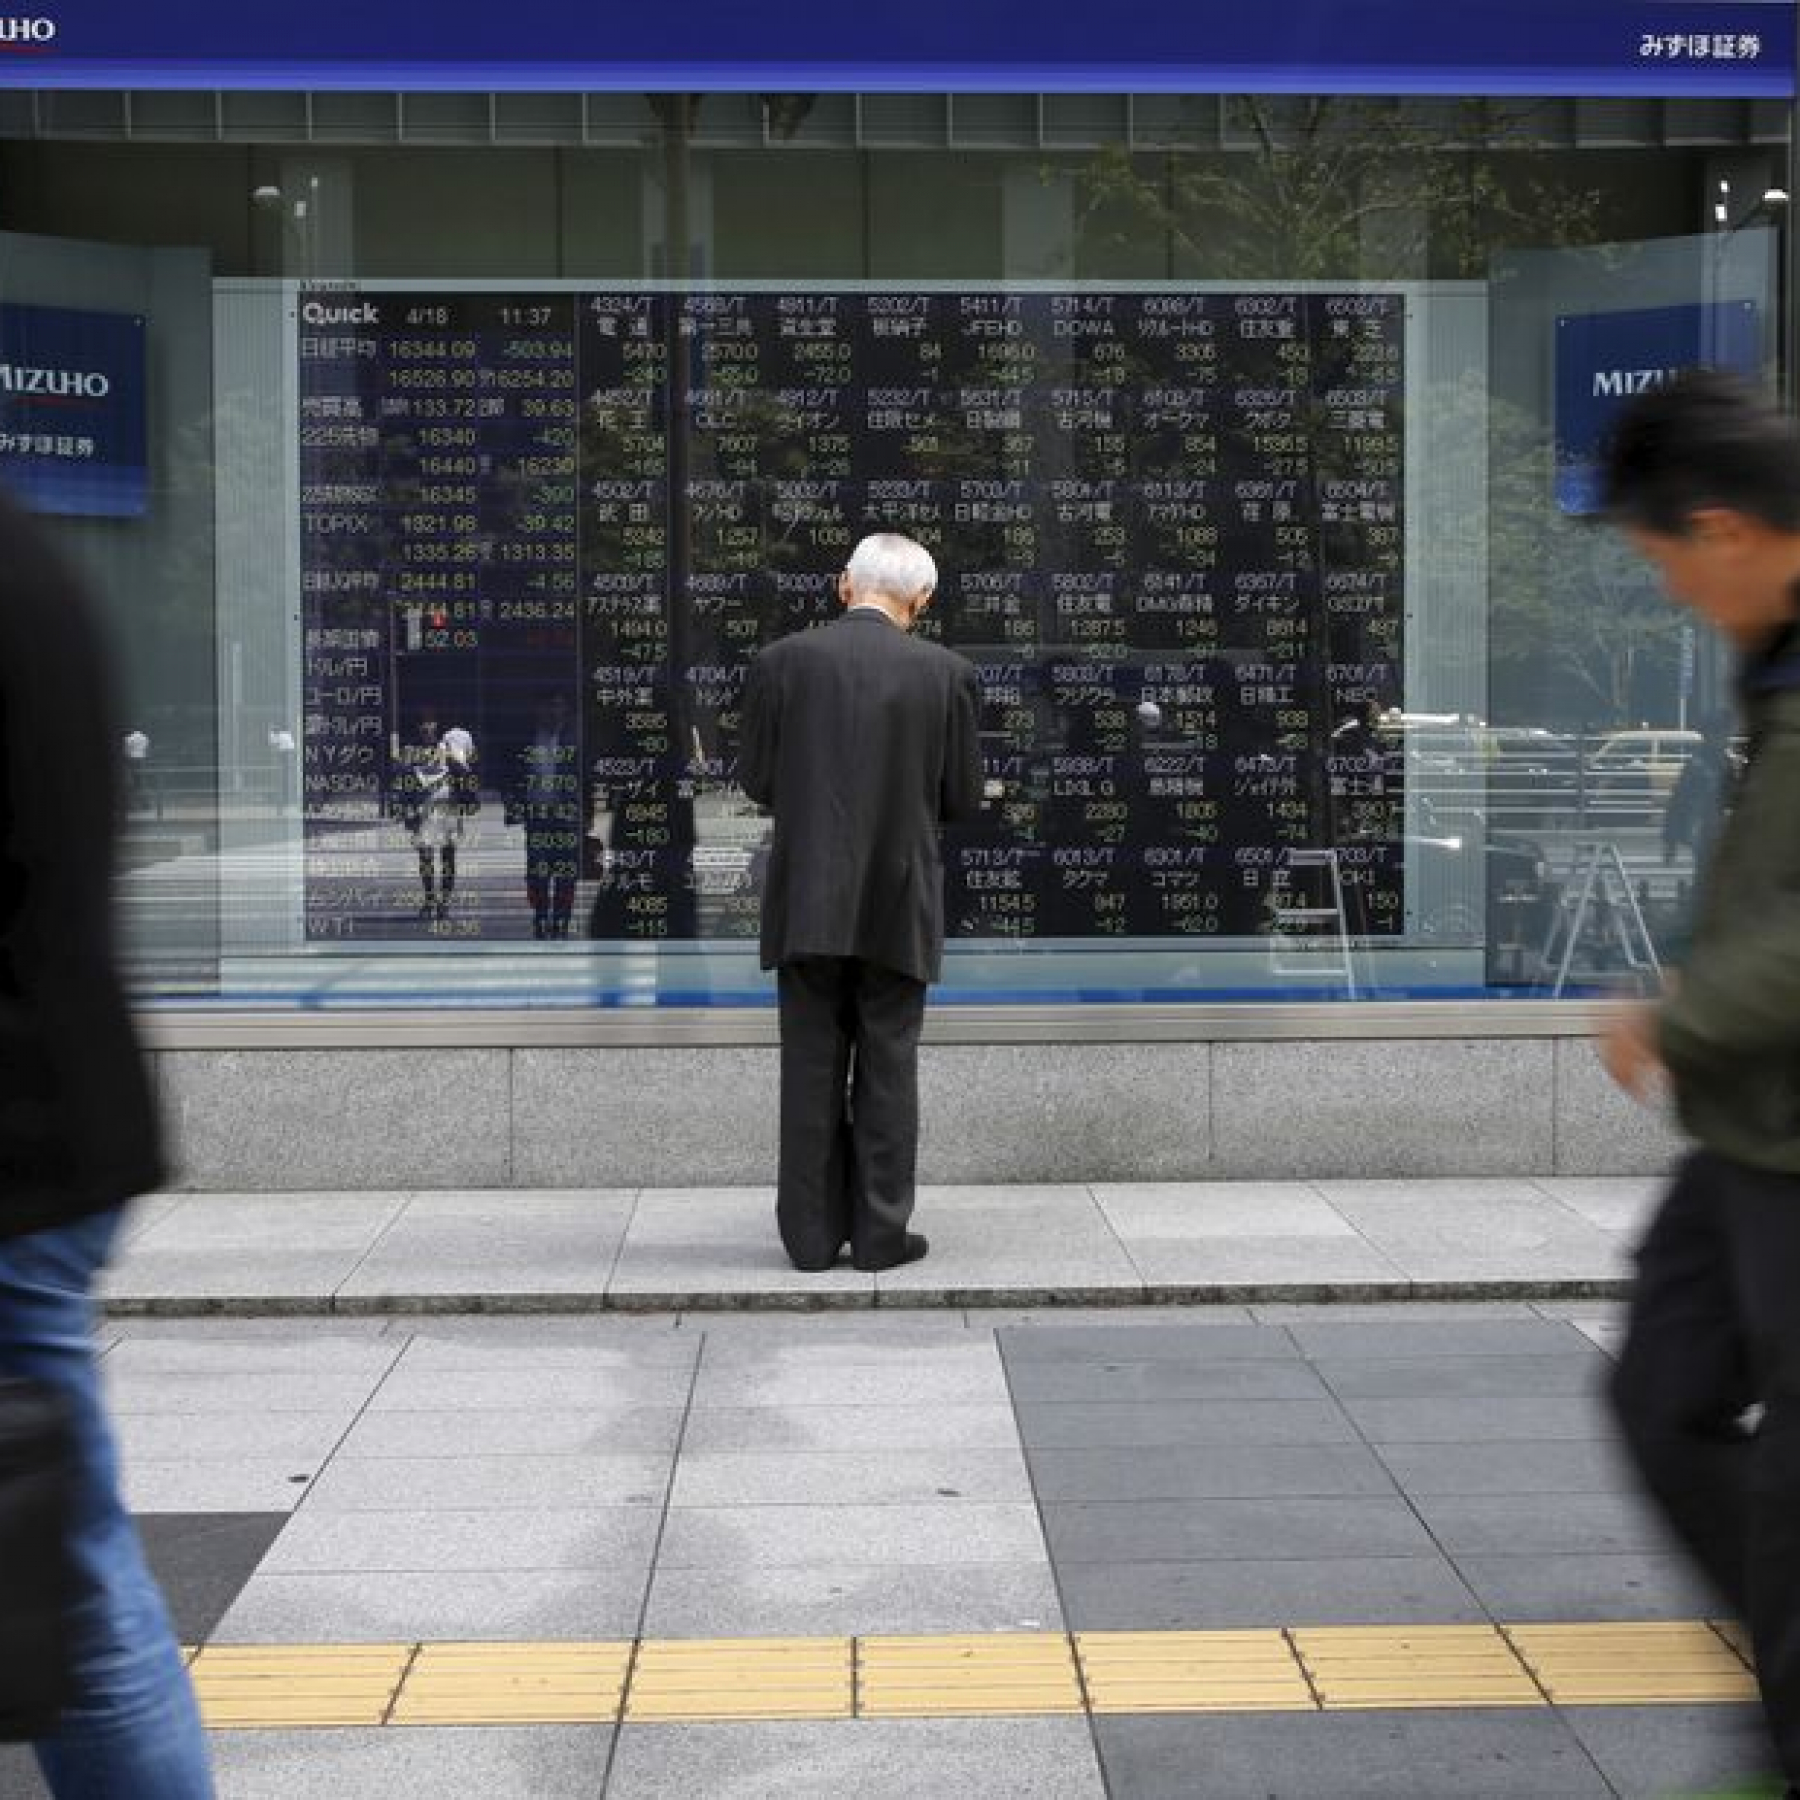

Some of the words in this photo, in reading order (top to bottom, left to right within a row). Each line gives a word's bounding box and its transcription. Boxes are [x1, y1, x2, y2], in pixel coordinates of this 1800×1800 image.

[1639, 34, 1760, 59] みずほ証券
[302, 301, 380, 325] Quick
[406, 308, 449, 324] 4/18
[959, 296, 1022, 314] 5411/T
[1052, 296, 1115, 314] 5714/T
[1053, 319, 1115, 336] DOWA
[918, 343, 942, 361] 84
[305, 515, 368, 534] TOPIX
[690, 595, 742, 613] ヤフー
[1234, 595, 1300, 614] ダイキン
[726, 619, 758, 638] 507
[684, 665, 747, 683] 4704/T
[1335, 688, 1378, 705] NEC
[593, 757, 657, 776] 4523/T
[305, 773, 380, 792] NASDAQ
[960, 848, 1023, 866] 5713/T
